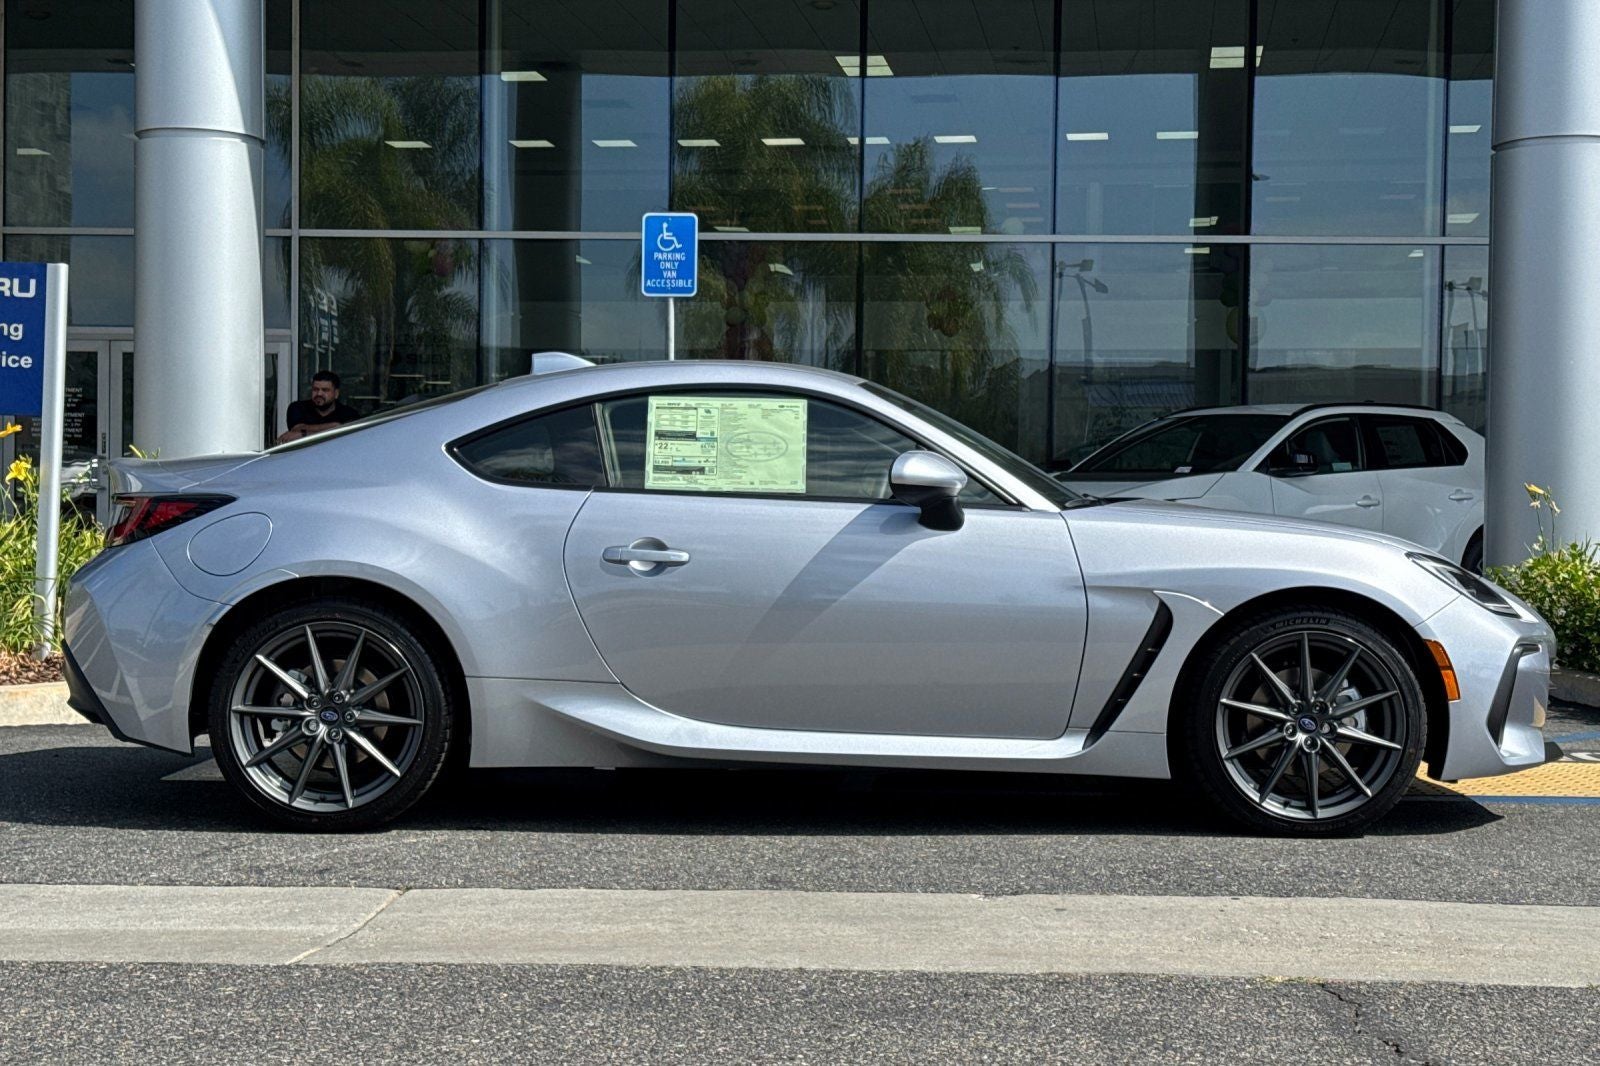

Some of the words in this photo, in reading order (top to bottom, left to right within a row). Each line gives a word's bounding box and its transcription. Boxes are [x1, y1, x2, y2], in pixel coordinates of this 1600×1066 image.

[654, 252, 686, 261] PARKING
[660, 261, 679, 270] ONLY
[663, 270, 677, 279] VAN
[646, 279, 693, 288] ACCESSIBLE
[0, 350, 33, 369] ice
[1275, 617, 1328, 629] MICHELIN
